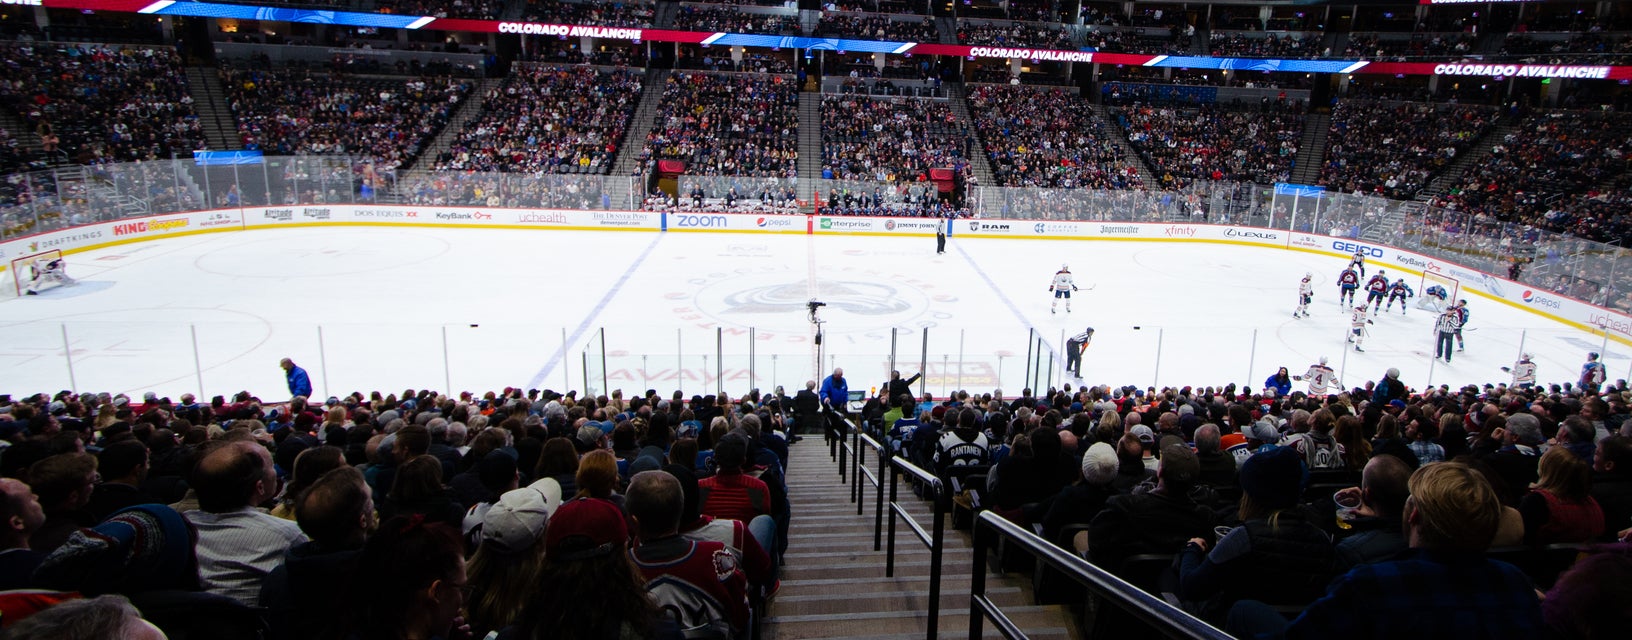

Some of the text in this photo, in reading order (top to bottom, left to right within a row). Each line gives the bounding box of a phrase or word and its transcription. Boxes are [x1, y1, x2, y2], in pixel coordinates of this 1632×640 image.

[498, 22, 642, 40] COLORADO AVALANCHE
[970, 47, 1093, 63] COLORADO AVALANCHE
[1434, 64, 1608, 79] COLORADO AVALANCHE
[355, 209, 375, 217] DOS
[377, 210, 404, 218] EQUIS
[436, 212, 472, 221] KeyBank
[519, 211, 567, 223] uchealth
[678, 215, 727, 228] zoom
[768, 218, 791, 227] pepsi
[821, 218, 871, 229] enterprise
[113, 221, 147, 236] KING
[1165, 225, 1197, 237] xfinity
[41, 230, 103, 249] DRAFTKINGS
[1238, 231, 1277, 240] LEXUS
[1333, 241, 1384, 258] GEICO
[1397, 254, 1427, 269] KeyBank
[1535, 295, 1561, 310] pepsi
[1315, 374, 1323, 386] 4
[950, 445, 982, 459] RANTANEN
